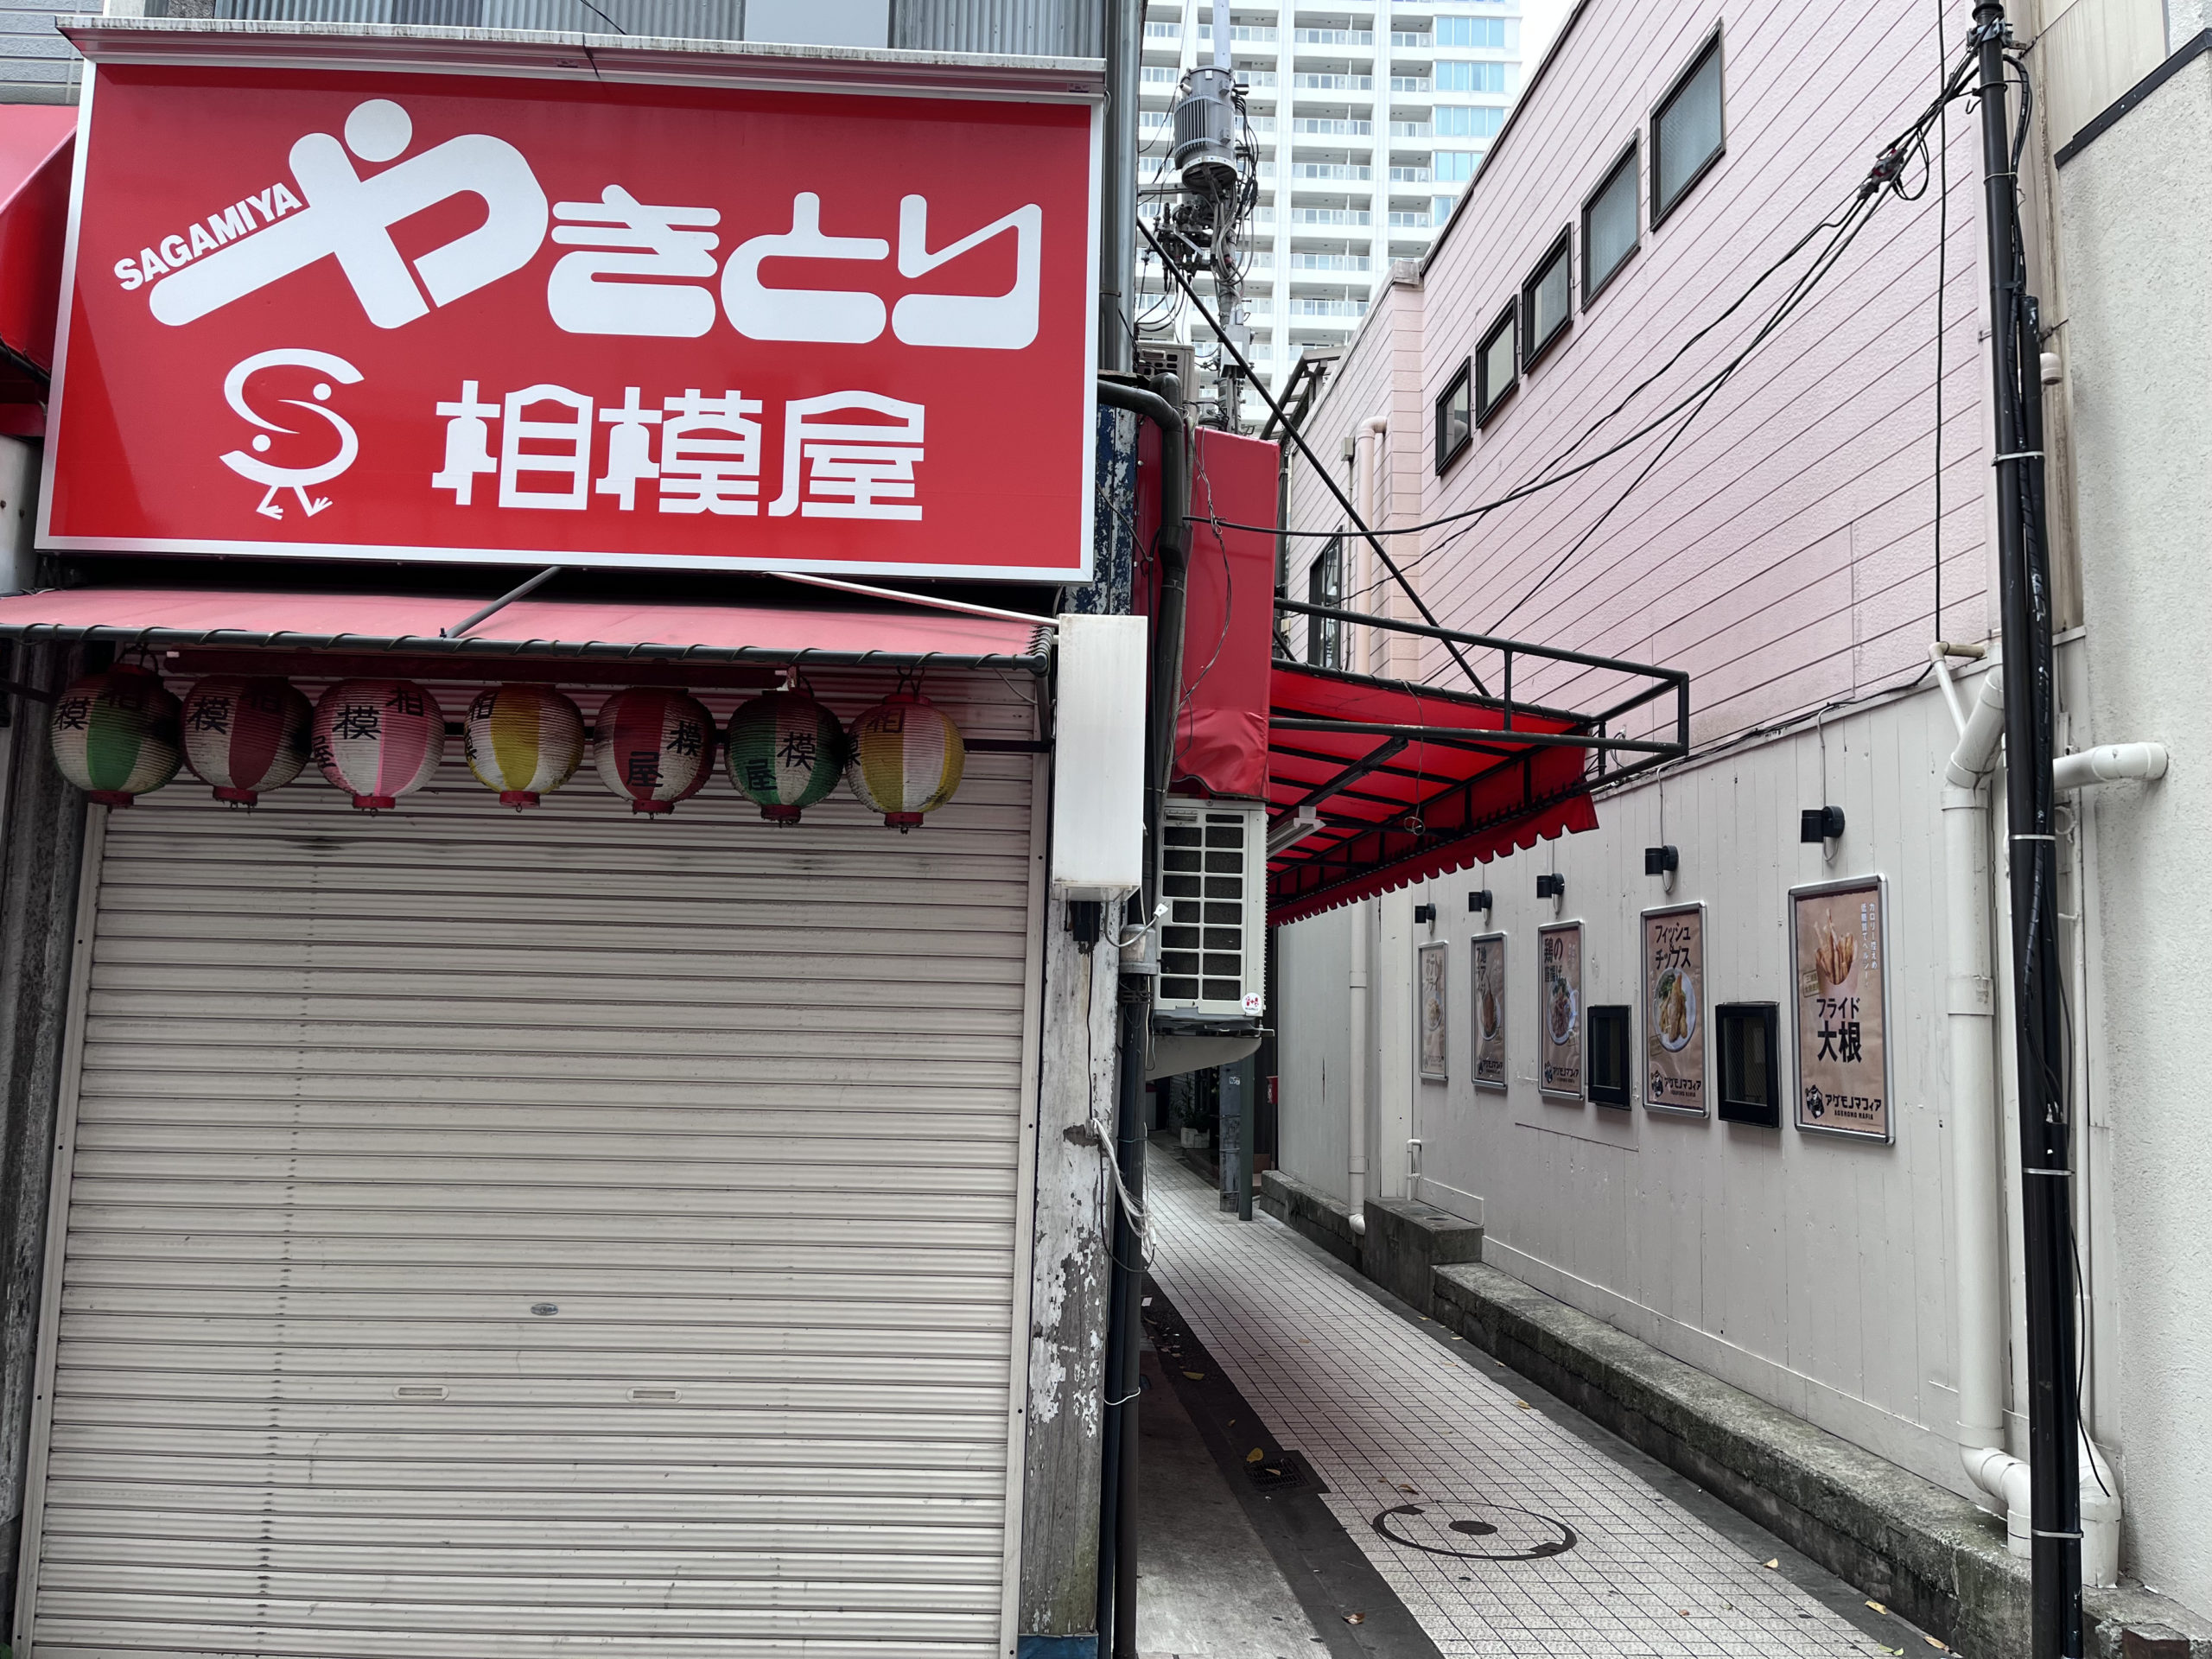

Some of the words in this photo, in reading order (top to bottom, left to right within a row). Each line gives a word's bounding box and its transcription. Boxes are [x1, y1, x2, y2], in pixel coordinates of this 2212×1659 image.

[113, 181, 303, 291] SAGAMIYA
[149, 99, 1043, 350] やきとり
[431, 380, 925, 521] 相模屋
[1655, 921, 1691, 944] フィッシュ
[1655, 945, 1691, 969] チップス
[1816, 996, 1860, 1020] フライド
[1817, 1020, 1862, 1064] 大根
[1858, 1112, 1873, 1121] MAFIA
